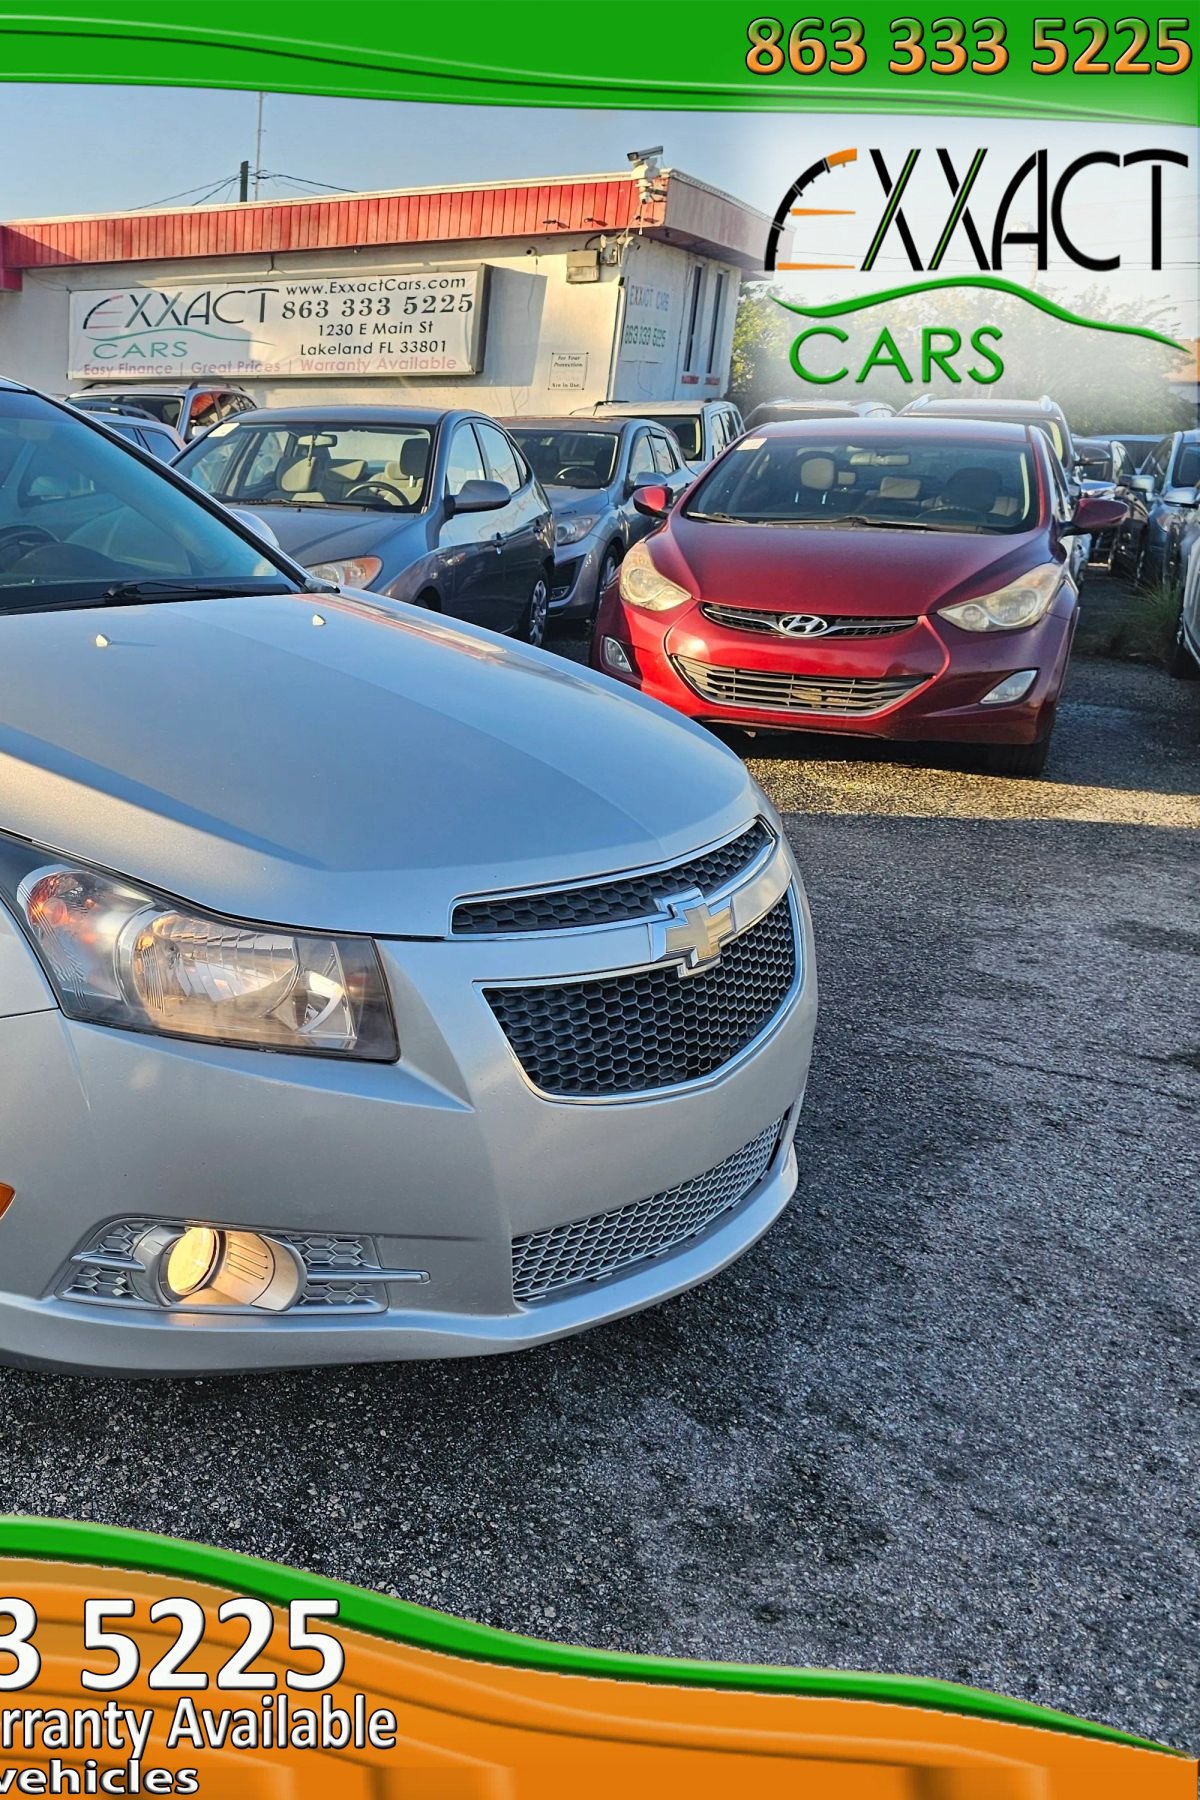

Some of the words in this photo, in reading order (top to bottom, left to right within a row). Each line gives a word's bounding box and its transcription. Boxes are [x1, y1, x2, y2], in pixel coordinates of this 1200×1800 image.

[286, 278, 466, 295] www.ExxactCars.com
[82, 287, 280, 329] EXXACT
[282, 299, 329, 319] 863
[341, 297, 391, 317] 333
[403, 293, 473, 315] 5225
[319, 323, 354, 337] 1230
[359, 323, 368, 335] E
[372, 322, 413, 335] Main
[419, 320, 434, 333] St
[92, 341, 188, 360] CARS
[300, 342, 373, 356] Lakeland
[379, 341, 394, 354] FL
[399, 340, 447, 353] 33801
[84, 363, 114, 377] Easy
[118, 362, 173, 375] Finance
[191, 360, 232, 374] Great
[237, 359, 281, 373] Prices
[300, 357, 371, 374] Warranty
[376, 355, 457, 370] Available
